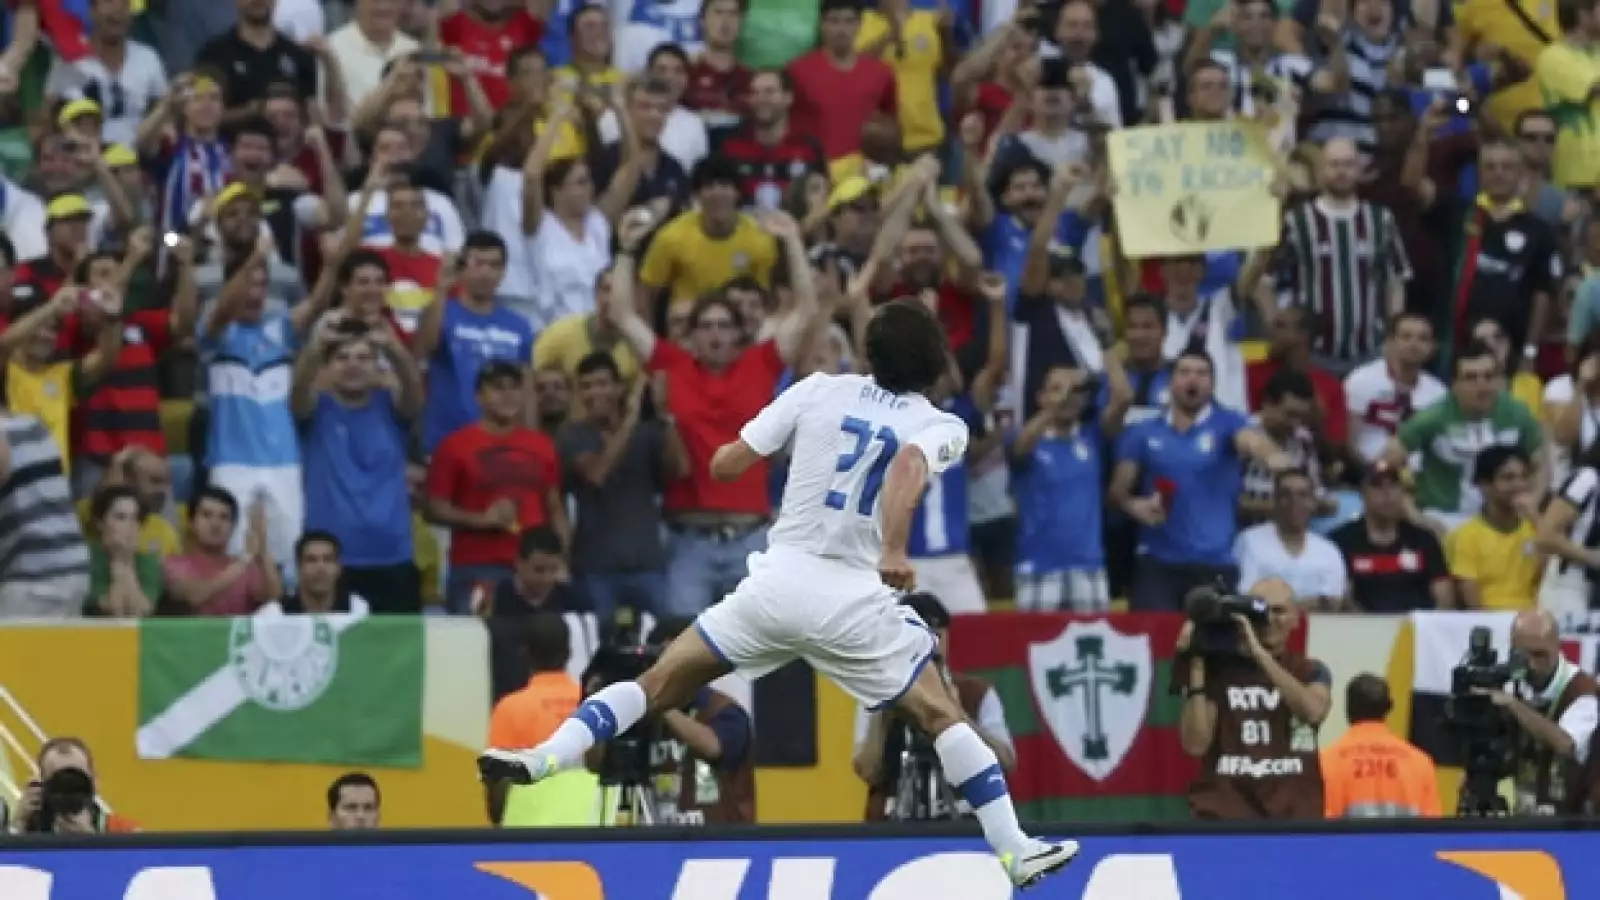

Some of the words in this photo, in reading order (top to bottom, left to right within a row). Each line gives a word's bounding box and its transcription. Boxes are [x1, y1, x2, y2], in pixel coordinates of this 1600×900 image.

[1126, 134, 1184, 163] SAY
[1206, 129, 1246, 160] NO
[1128, 165, 1164, 197] TO
[825, 415, 899, 516] 21
[1227, 686, 1280, 711] RTV
[1241, 719, 1271, 746] 81
